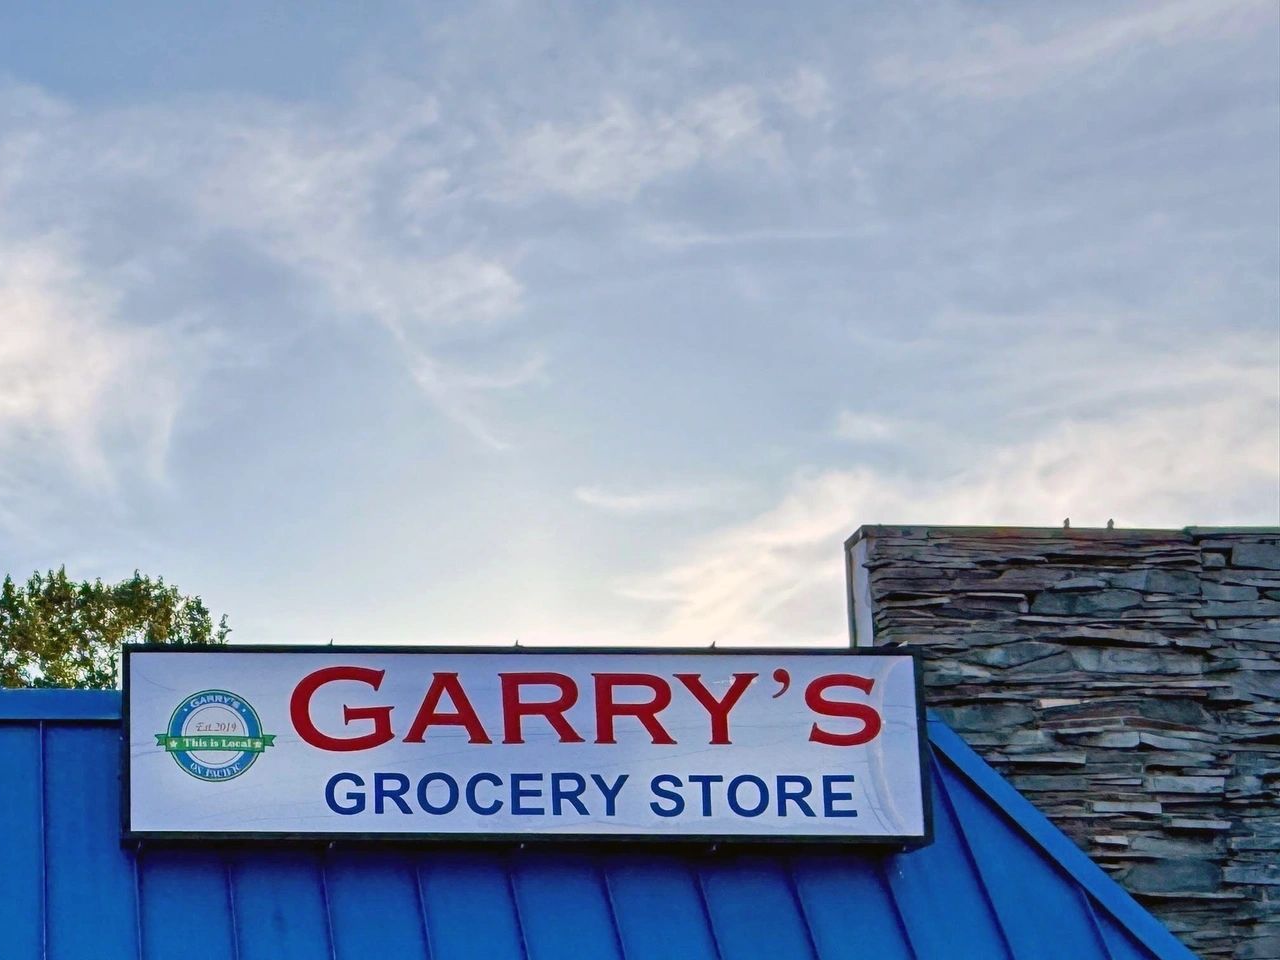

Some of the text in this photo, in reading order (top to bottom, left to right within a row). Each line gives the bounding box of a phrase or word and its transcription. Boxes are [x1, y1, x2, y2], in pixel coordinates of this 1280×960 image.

[190, 695, 240, 708] GARRY'S
[290, 666, 882, 752] GARRY'S
[184, 738, 252, 749] This is Local
[325, 771, 858, 818] GROCERY STORE
